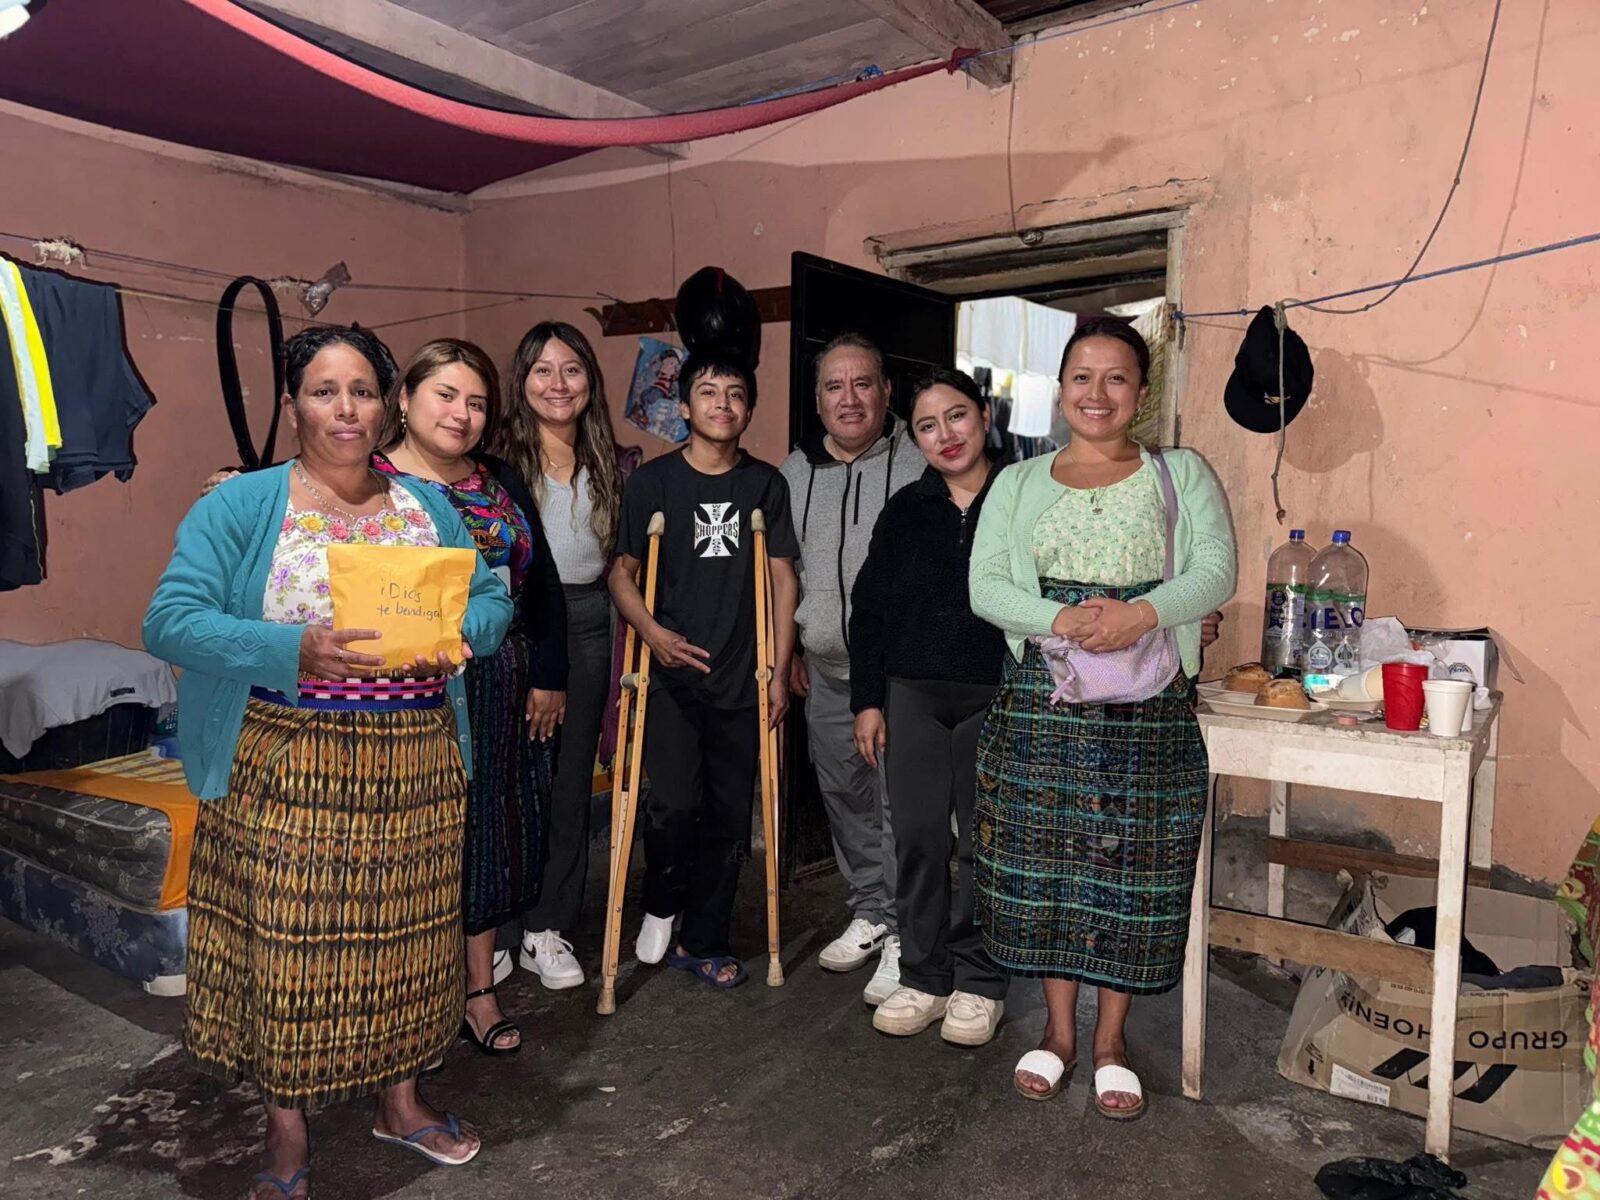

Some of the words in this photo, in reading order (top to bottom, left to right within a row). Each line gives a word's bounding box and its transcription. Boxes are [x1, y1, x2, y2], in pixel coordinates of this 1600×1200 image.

[695, 522, 738, 539] CHOPPERS
[376, 603, 391, 617] te
[1303, 606, 1364, 630] IELO
[1340, 990, 1431, 1040] HOENI
[1468, 1030, 1568, 1050] GRUPO
